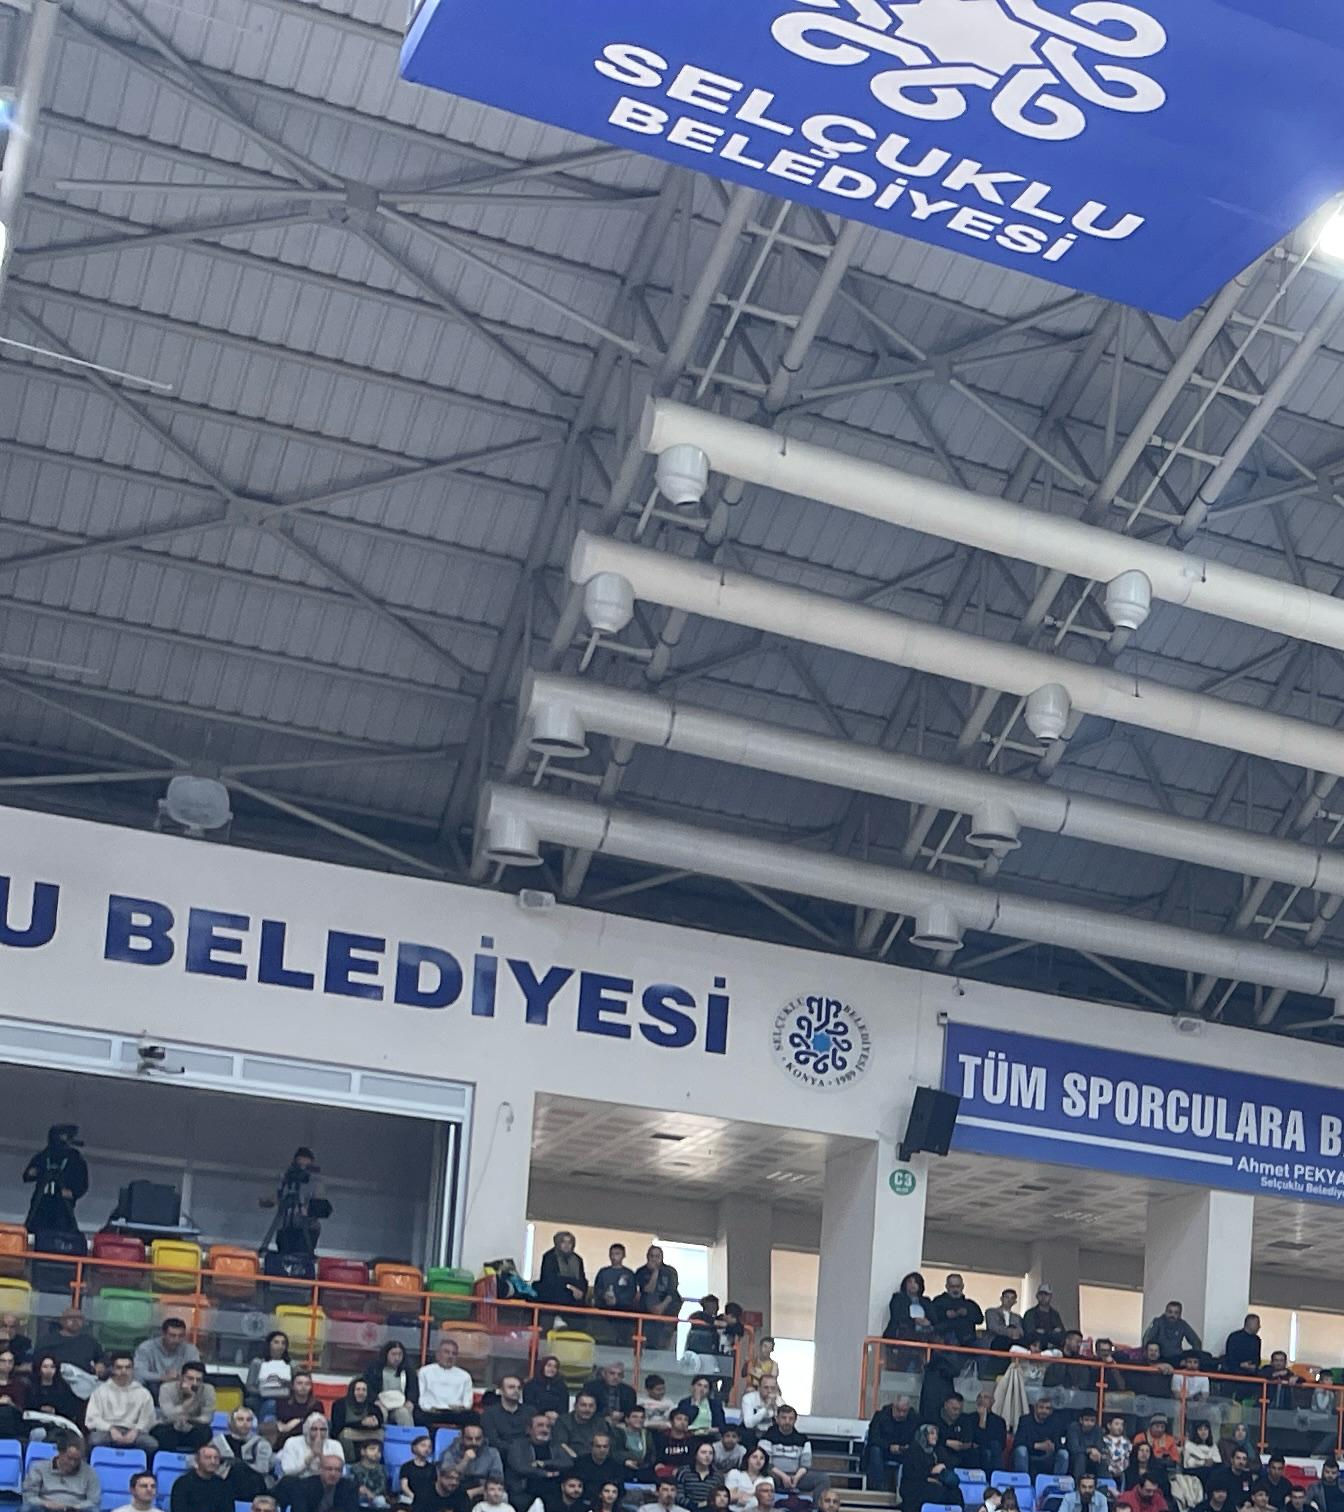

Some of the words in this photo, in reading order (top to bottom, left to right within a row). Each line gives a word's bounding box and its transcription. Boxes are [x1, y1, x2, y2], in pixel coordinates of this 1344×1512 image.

[594, 42, 1146, 243] SELÇUKLU
[607, 95, 1078, 262] BELEDİYESİ
[104, 894, 730, 1055] BELEDİYESİ
[785, 1061, 826, 1088] KONYA
[958, 1050, 1047, 1112] TÜM
[1062, 1071, 1307, 1152] SPORCULARA
[1237, 1155, 1290, 1178] Ahmet
[1260, 1176, 1304, 1193] Selçuklu
